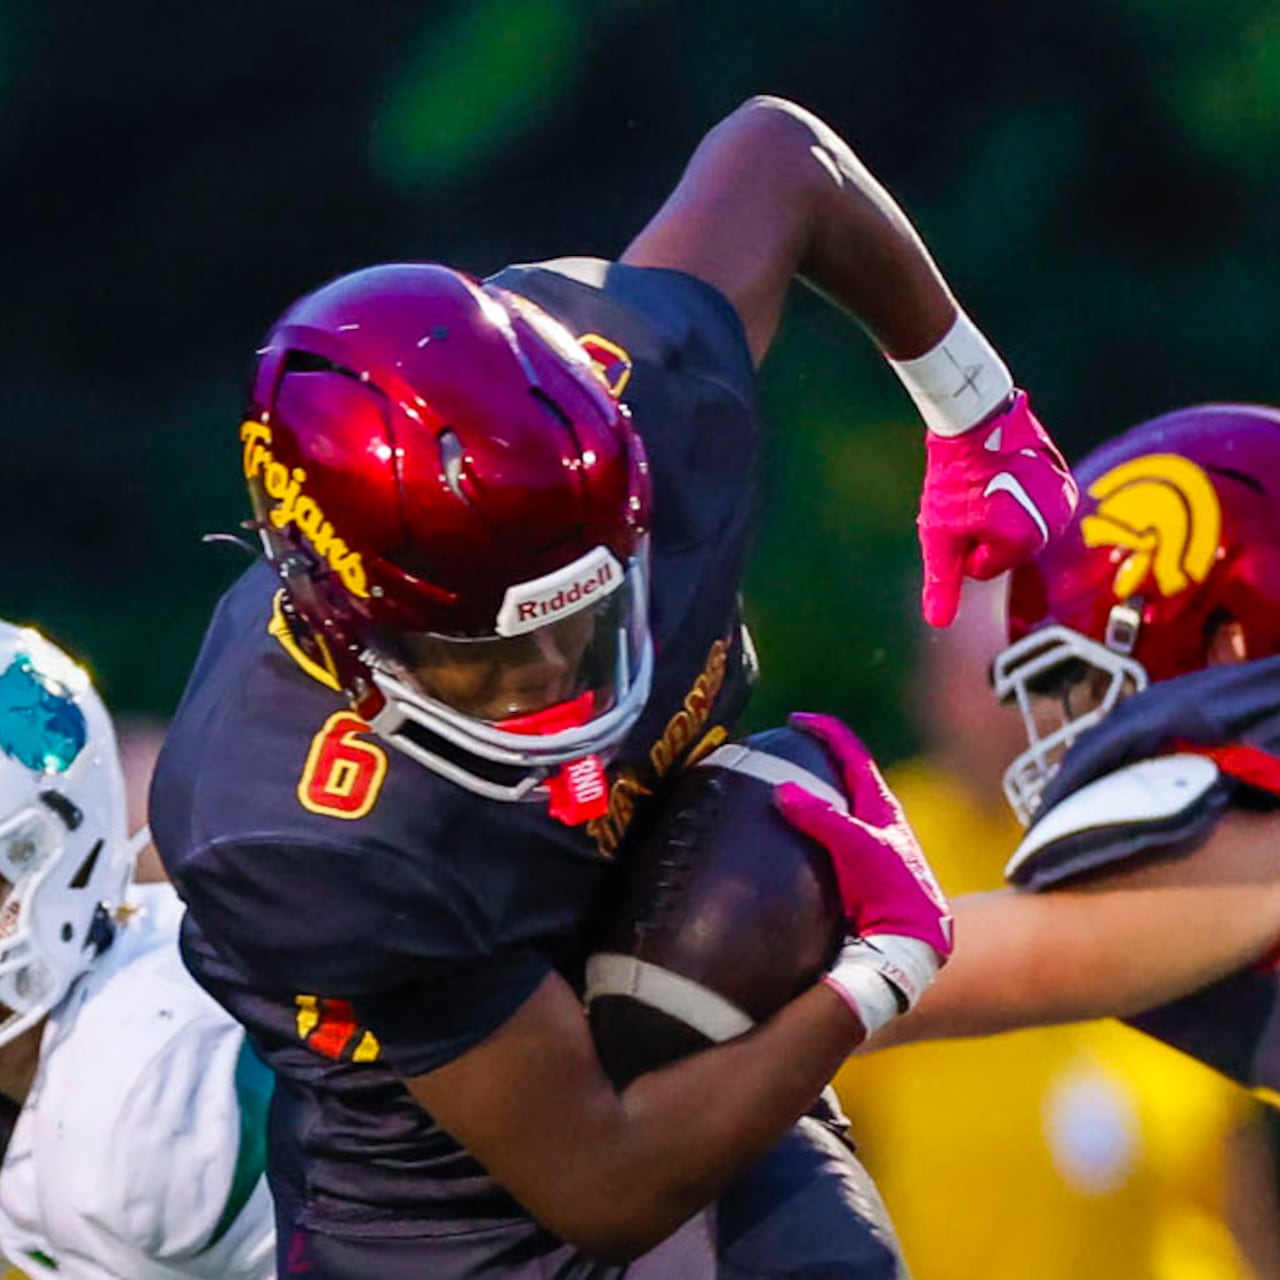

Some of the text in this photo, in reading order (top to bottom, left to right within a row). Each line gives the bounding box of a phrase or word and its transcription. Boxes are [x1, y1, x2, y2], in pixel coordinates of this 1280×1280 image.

[240, 421, 371, 598] Trojans
[517, 563, 613, 621] Riddell
[297, 710, 389, 820] 6
